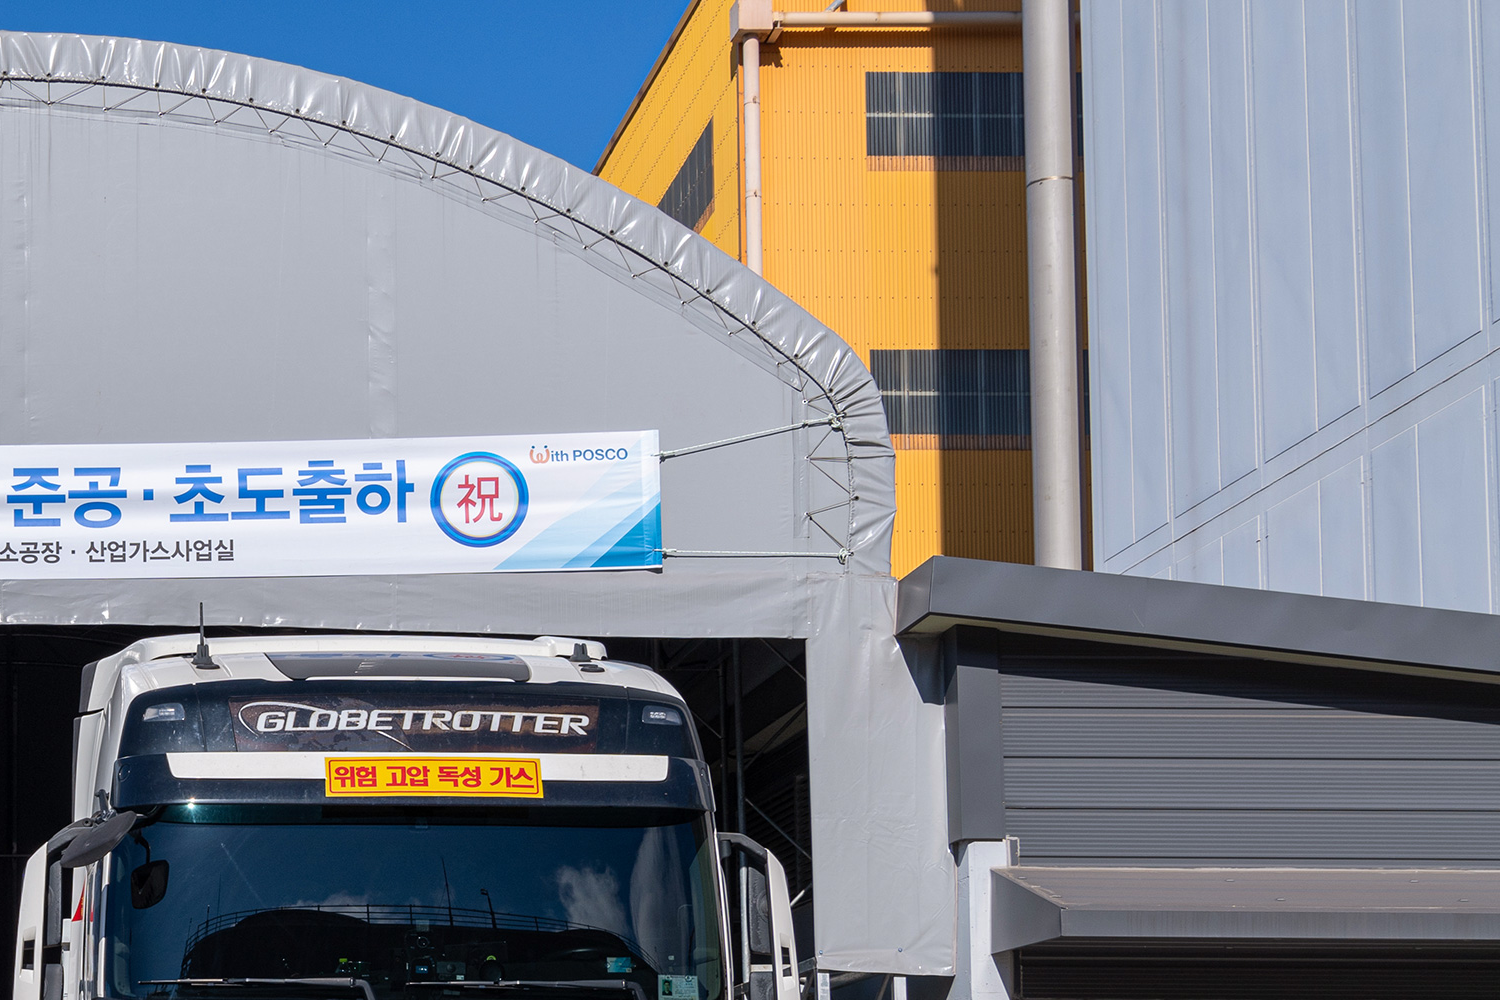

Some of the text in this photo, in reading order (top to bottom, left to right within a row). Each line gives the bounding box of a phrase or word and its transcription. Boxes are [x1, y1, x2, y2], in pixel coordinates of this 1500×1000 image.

[530, 445, 628, 463] With POSCO
[457, 474, 503, 526] 祝
[86, 540, 234, 562] 산업가스사업실
[256, 709, 591, 737] GLOBETROTTER
[333, 765, 535, 789] 위험 고압 독성 가스
